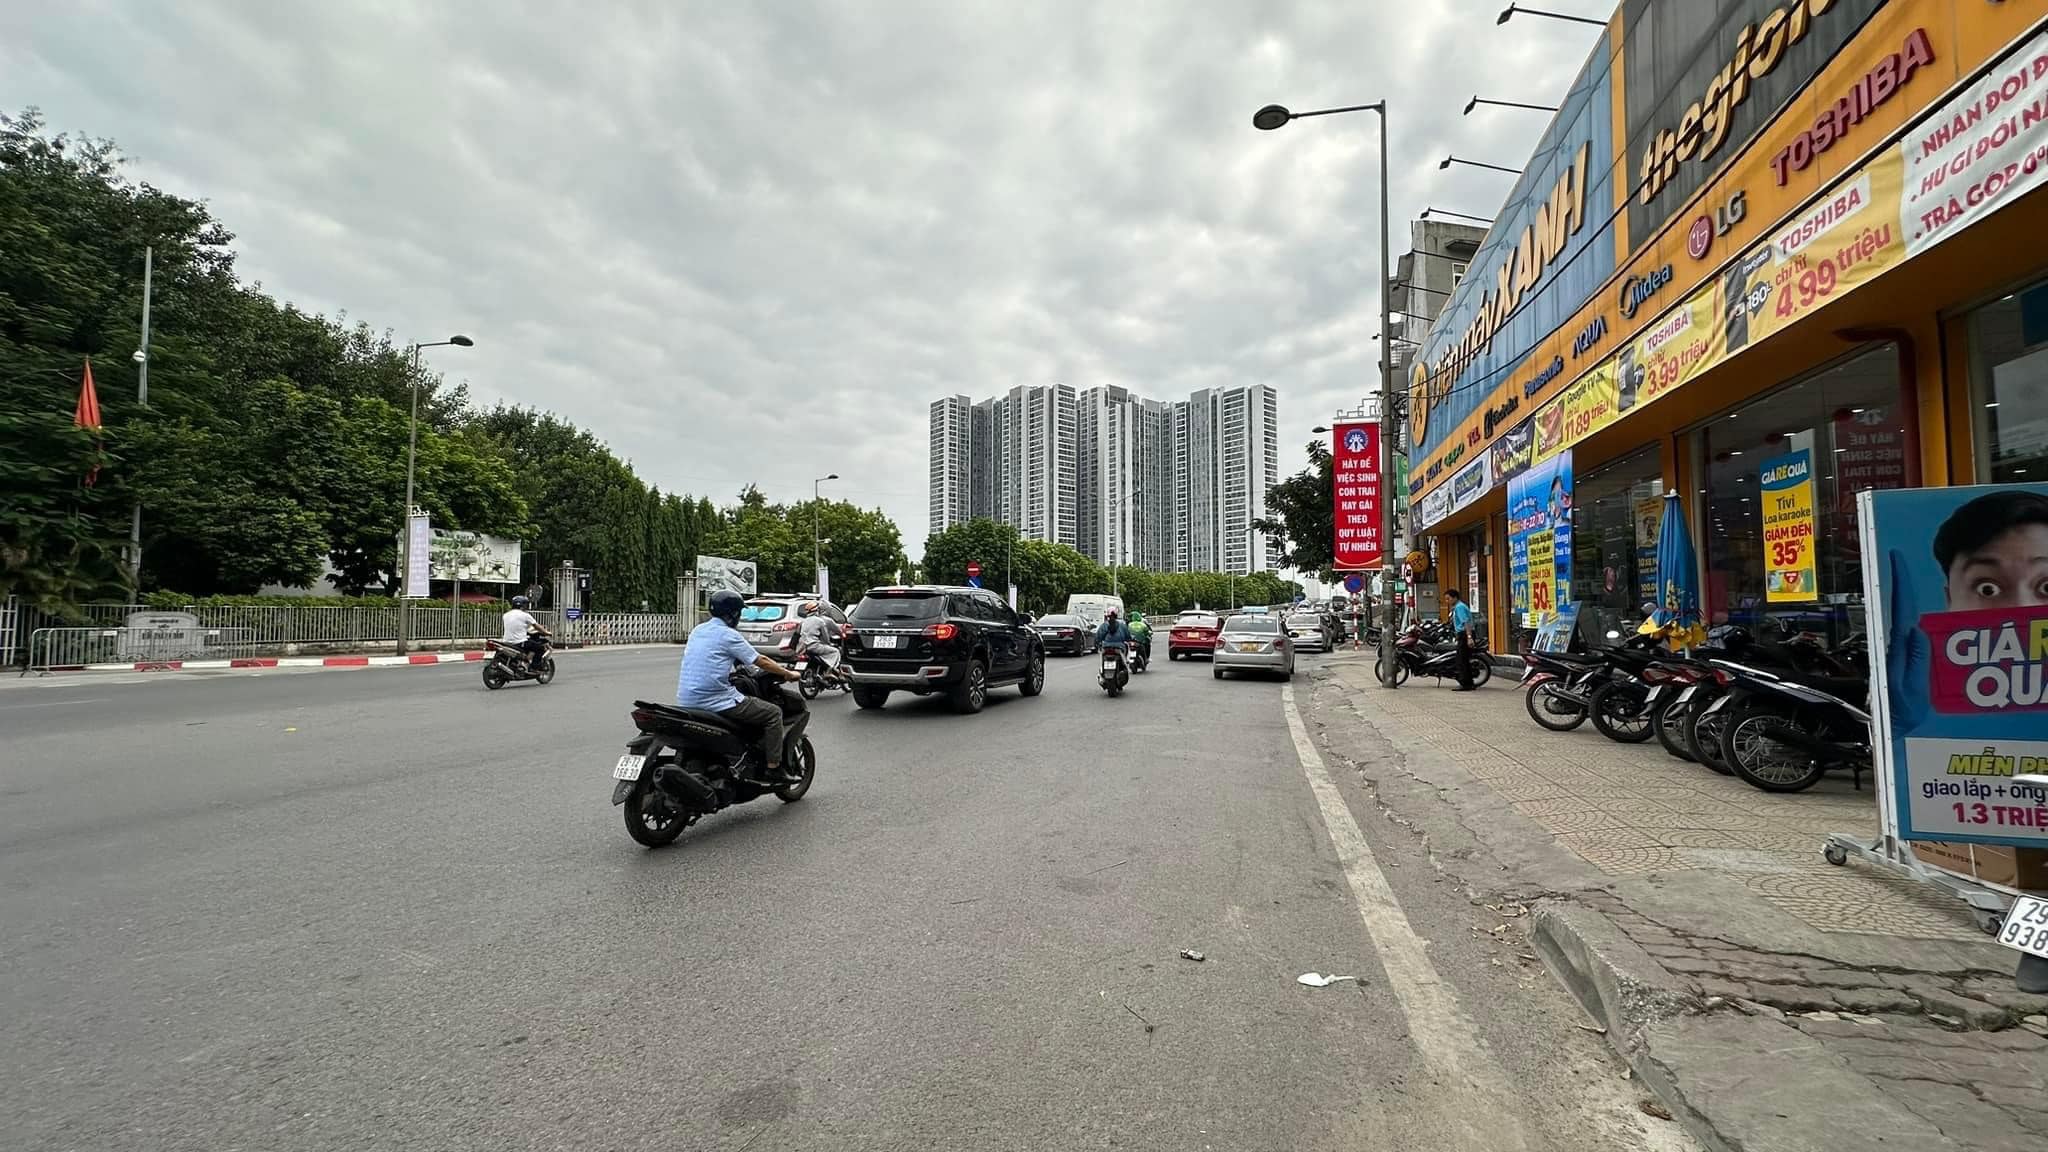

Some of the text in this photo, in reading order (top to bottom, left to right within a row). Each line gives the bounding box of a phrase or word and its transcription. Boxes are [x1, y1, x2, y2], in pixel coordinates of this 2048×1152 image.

[1770, 28, 1936, 187] TOSHIBA
[1495, 140, 1591, 326] XANH
[1716, 190, 1747, 236] LG
[1779, 187, 1862, 256] TOSHIBA
[1621, 264, 1673, 319] Midea
[1775, 223, 1893, 319] 4.99 triệu
[1647, 311, 1689, 352] TOSHIBA
[1648, 356, 1680, 396] 3.99
[1679, 338, 1710, 367] triệu
[1339, 486, 1376, 496] CON TRAI
[1347, 514, 1368, 524] THEO
[1764, 506, 1812, 525] Loa karaoke
[1765, 519, 1813, 543] GIẢM ĐẾN
[1772, 539, 1806, 567] 35%
[1946, 621, 2025, 666] GIÁ
[1966, 664, 2048, 709] QU
[1947, 746, 2016, 777] MIỄN
[1922, 778, 1961, 799] giao
[1964, 777, 1992, 801] lắp
[1952, 801, 1990, 825] 1.3
